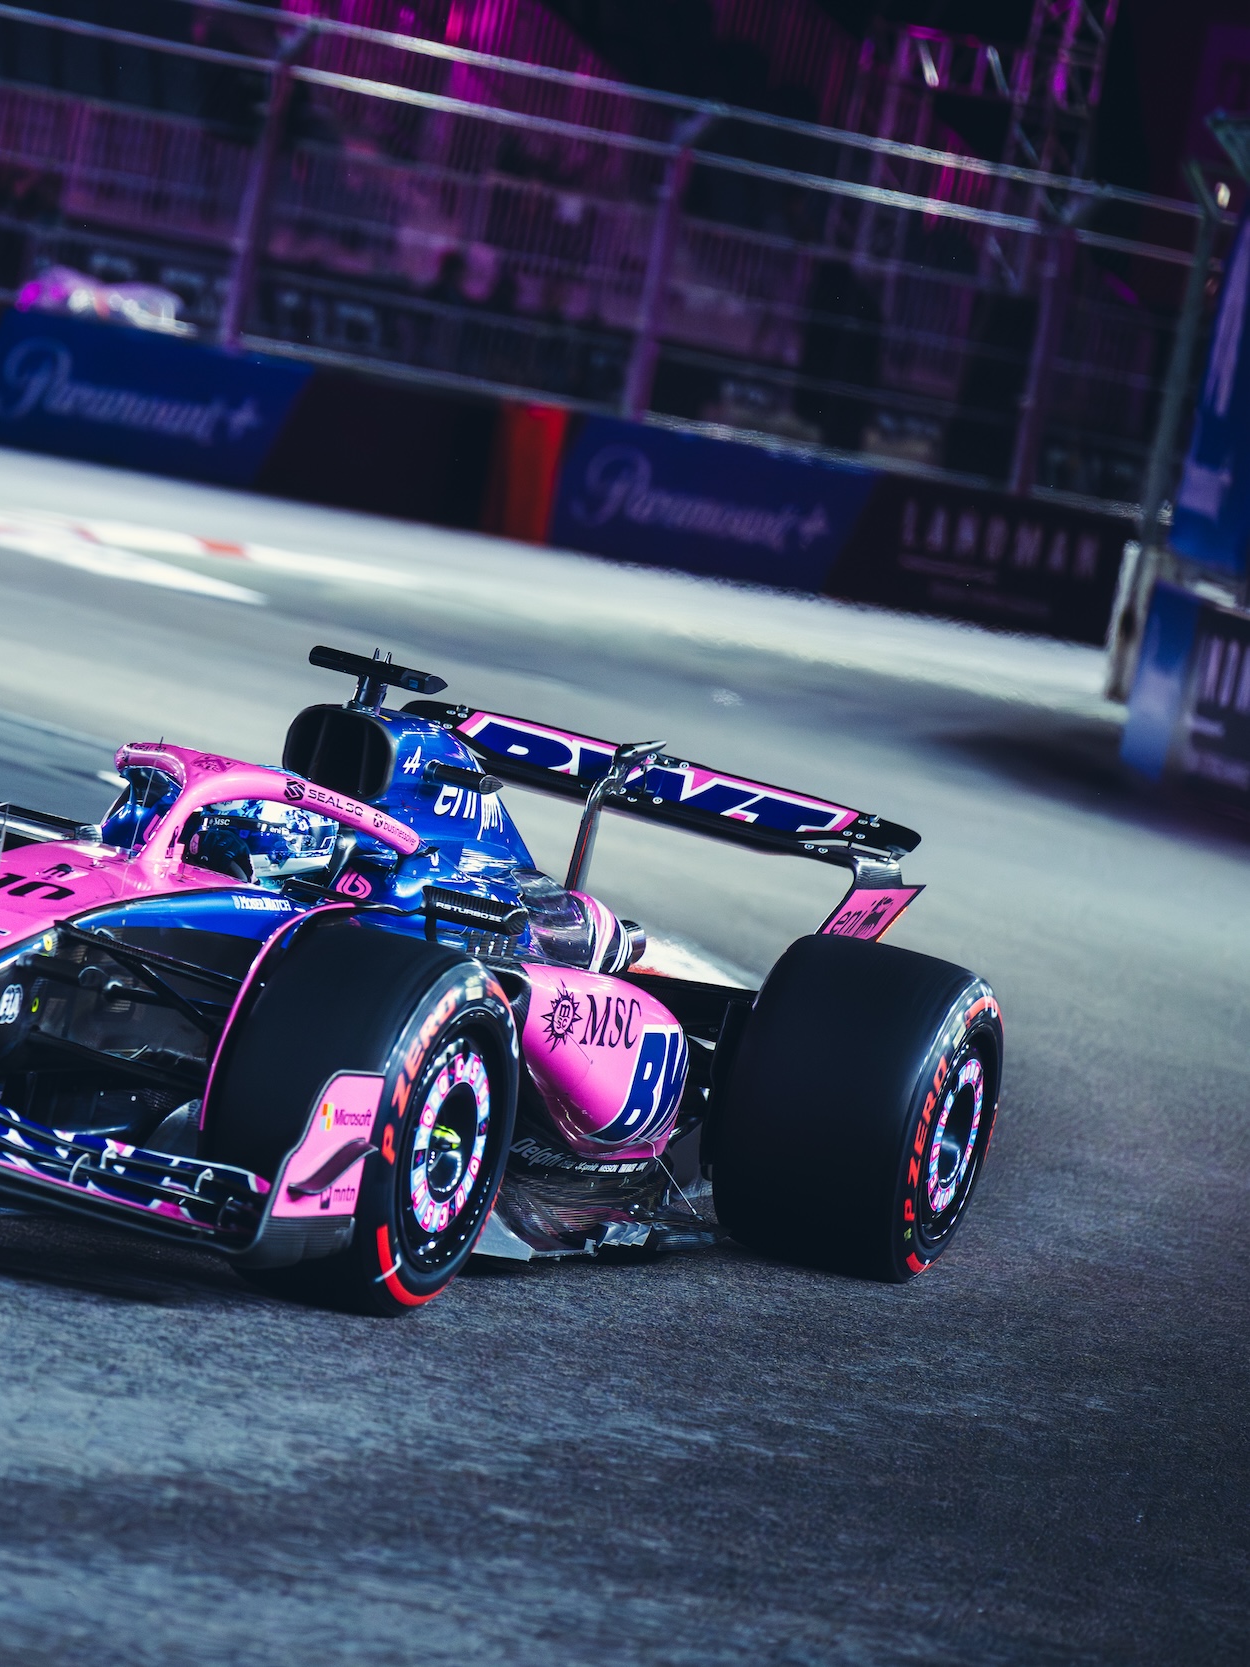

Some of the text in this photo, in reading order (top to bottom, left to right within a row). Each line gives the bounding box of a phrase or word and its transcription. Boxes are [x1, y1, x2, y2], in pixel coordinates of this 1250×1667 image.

[900, 497, 1101, 580] LANDMAN
[392, 989, 457, 1118] ZERO
[579, 994, 642, 1049] MSC
[334, 1109, 372, 1126] Microsoft
[510, 1138, 565, 1166] Delphi
[908, 1055, 948, 1189] ZERO
